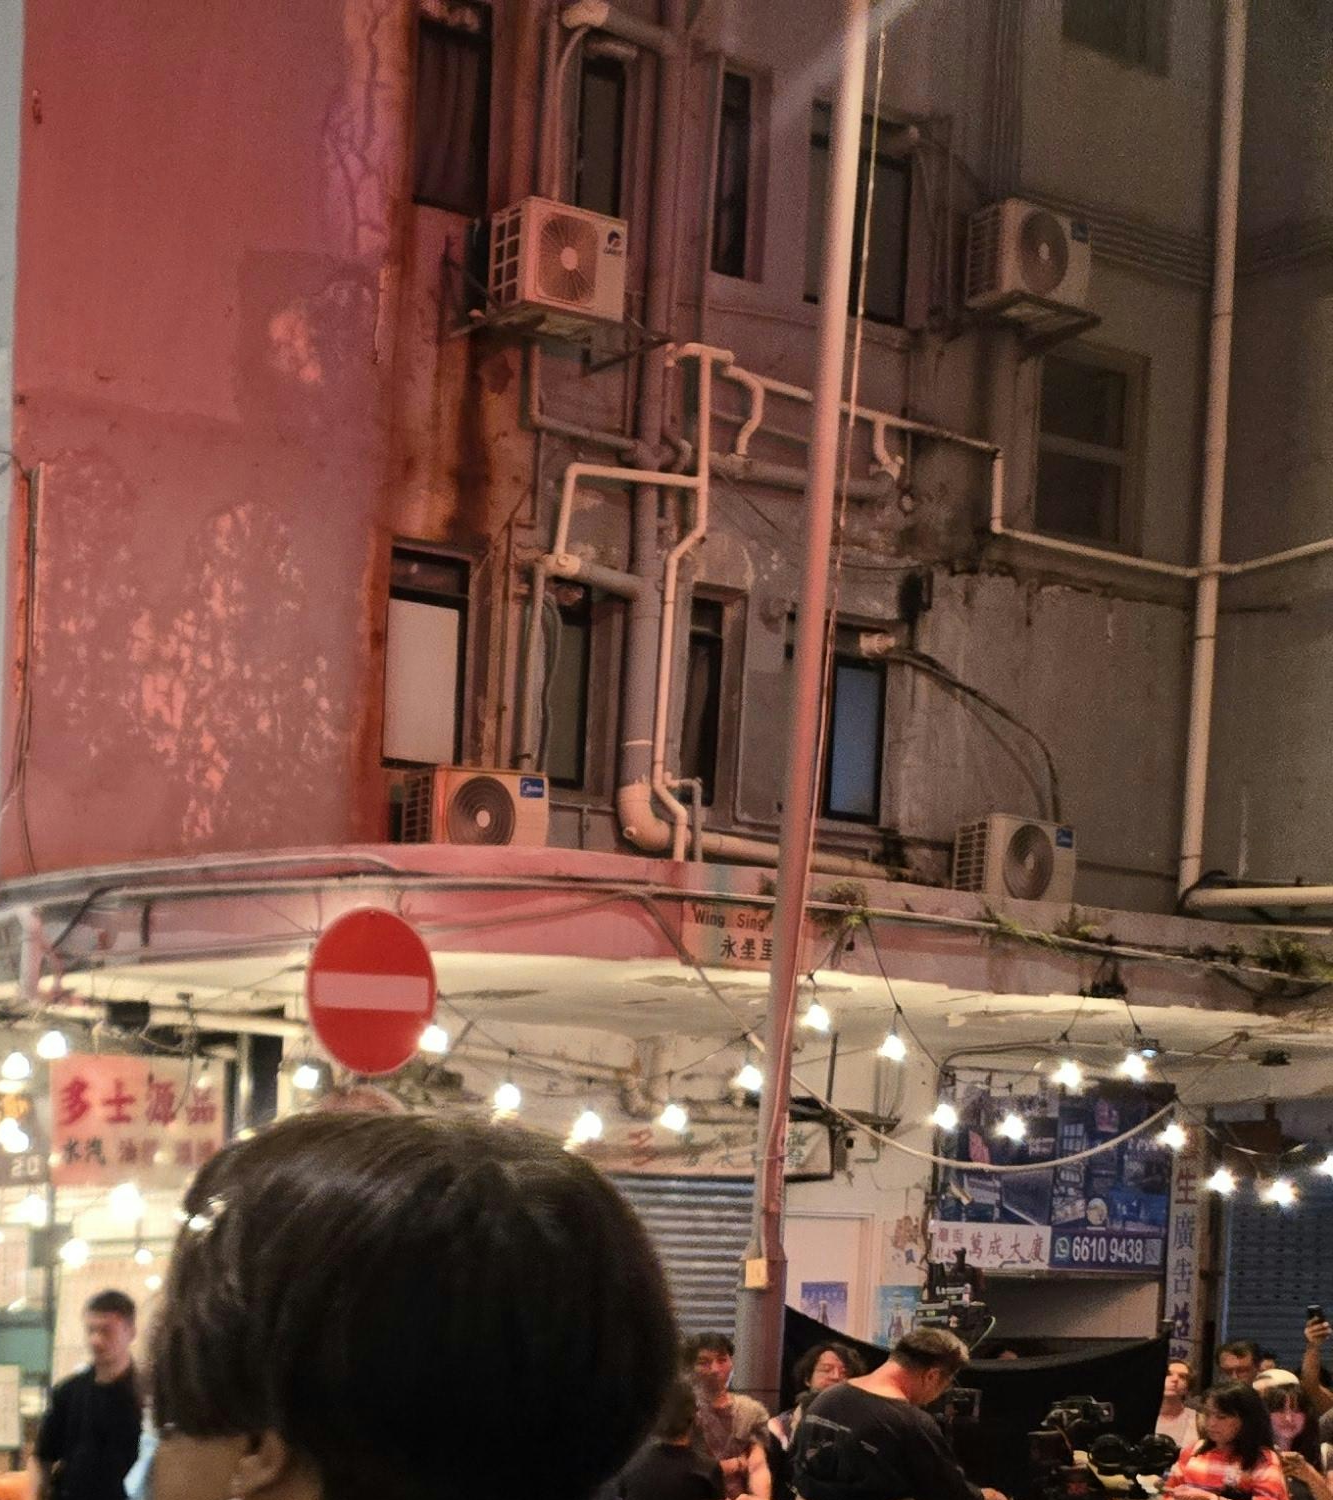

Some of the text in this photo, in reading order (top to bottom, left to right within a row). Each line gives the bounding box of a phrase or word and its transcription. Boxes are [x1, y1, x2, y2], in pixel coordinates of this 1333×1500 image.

[693, 904, 766, 932] Wing Sing
[1071, 1235, 1145, 1264] 6610 9438
